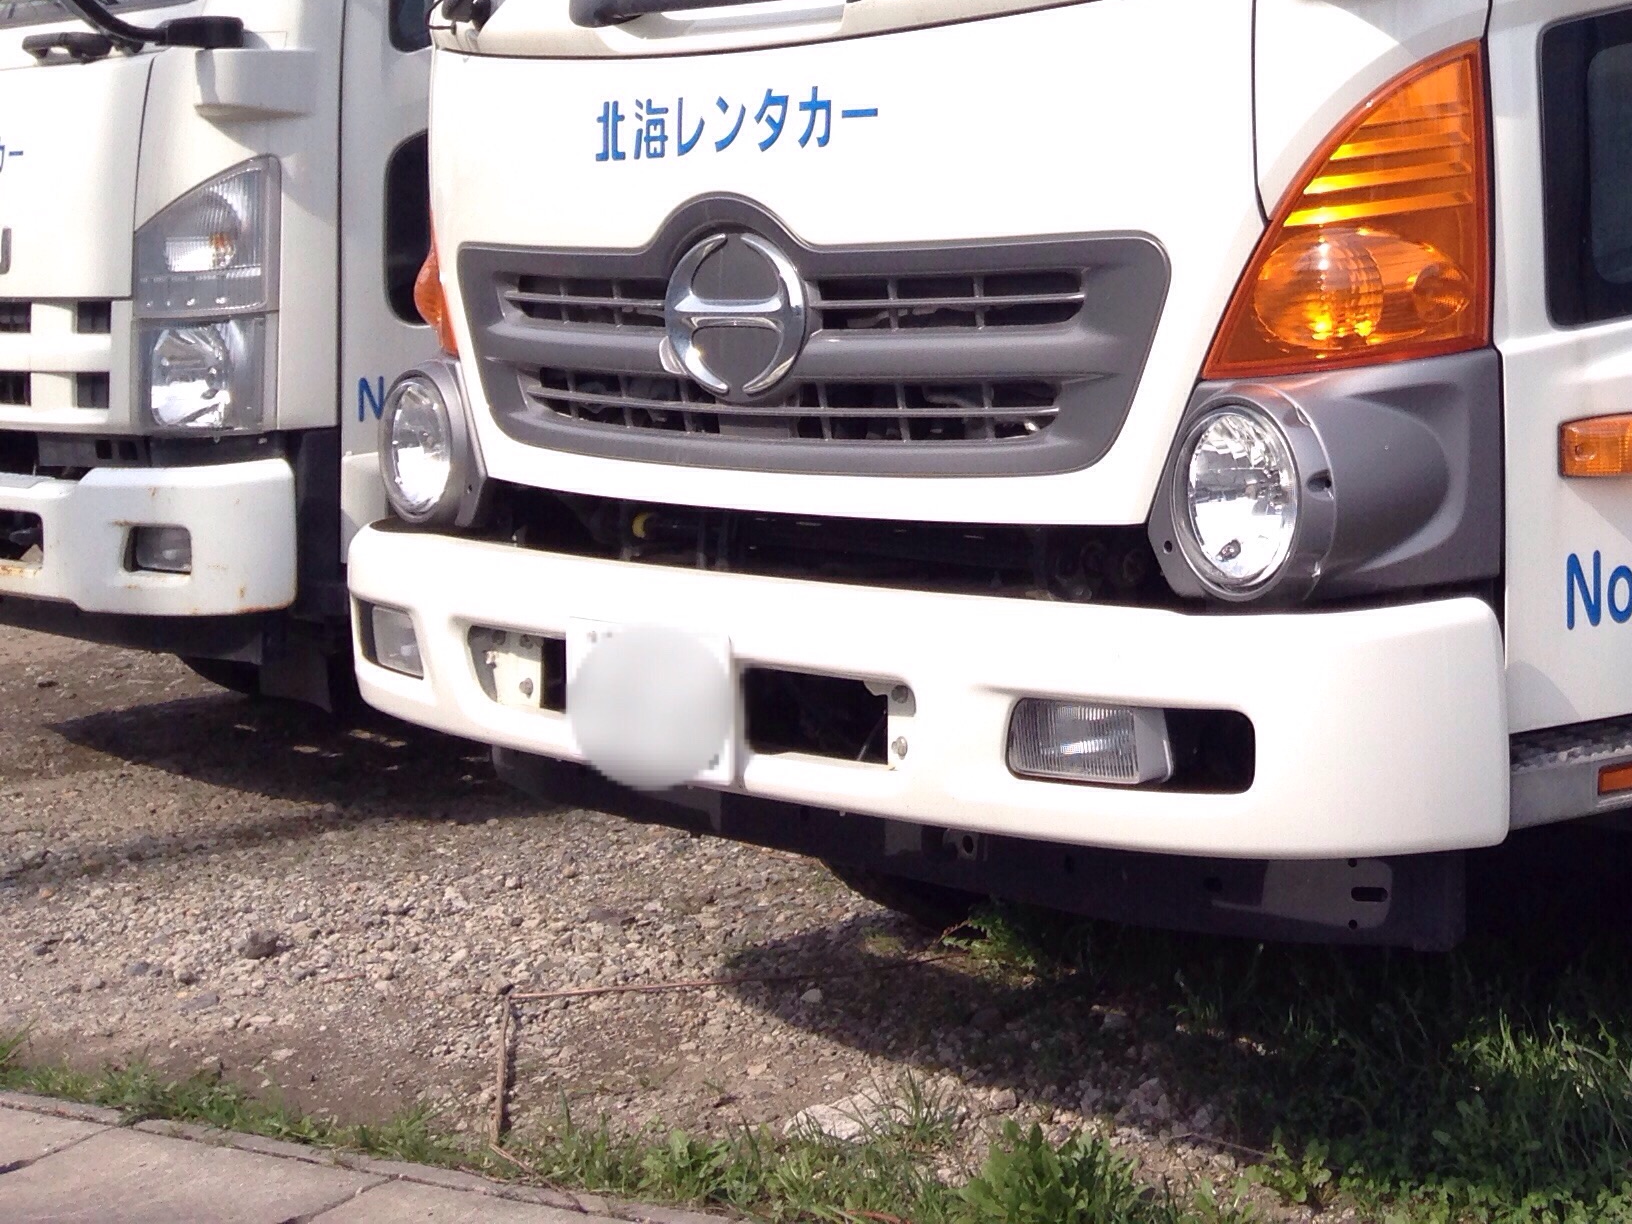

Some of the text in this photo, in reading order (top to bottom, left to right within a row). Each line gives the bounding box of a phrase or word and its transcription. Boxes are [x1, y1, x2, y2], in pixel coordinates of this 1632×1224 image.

[595, 86, 878, 162] 北海レンタカー
